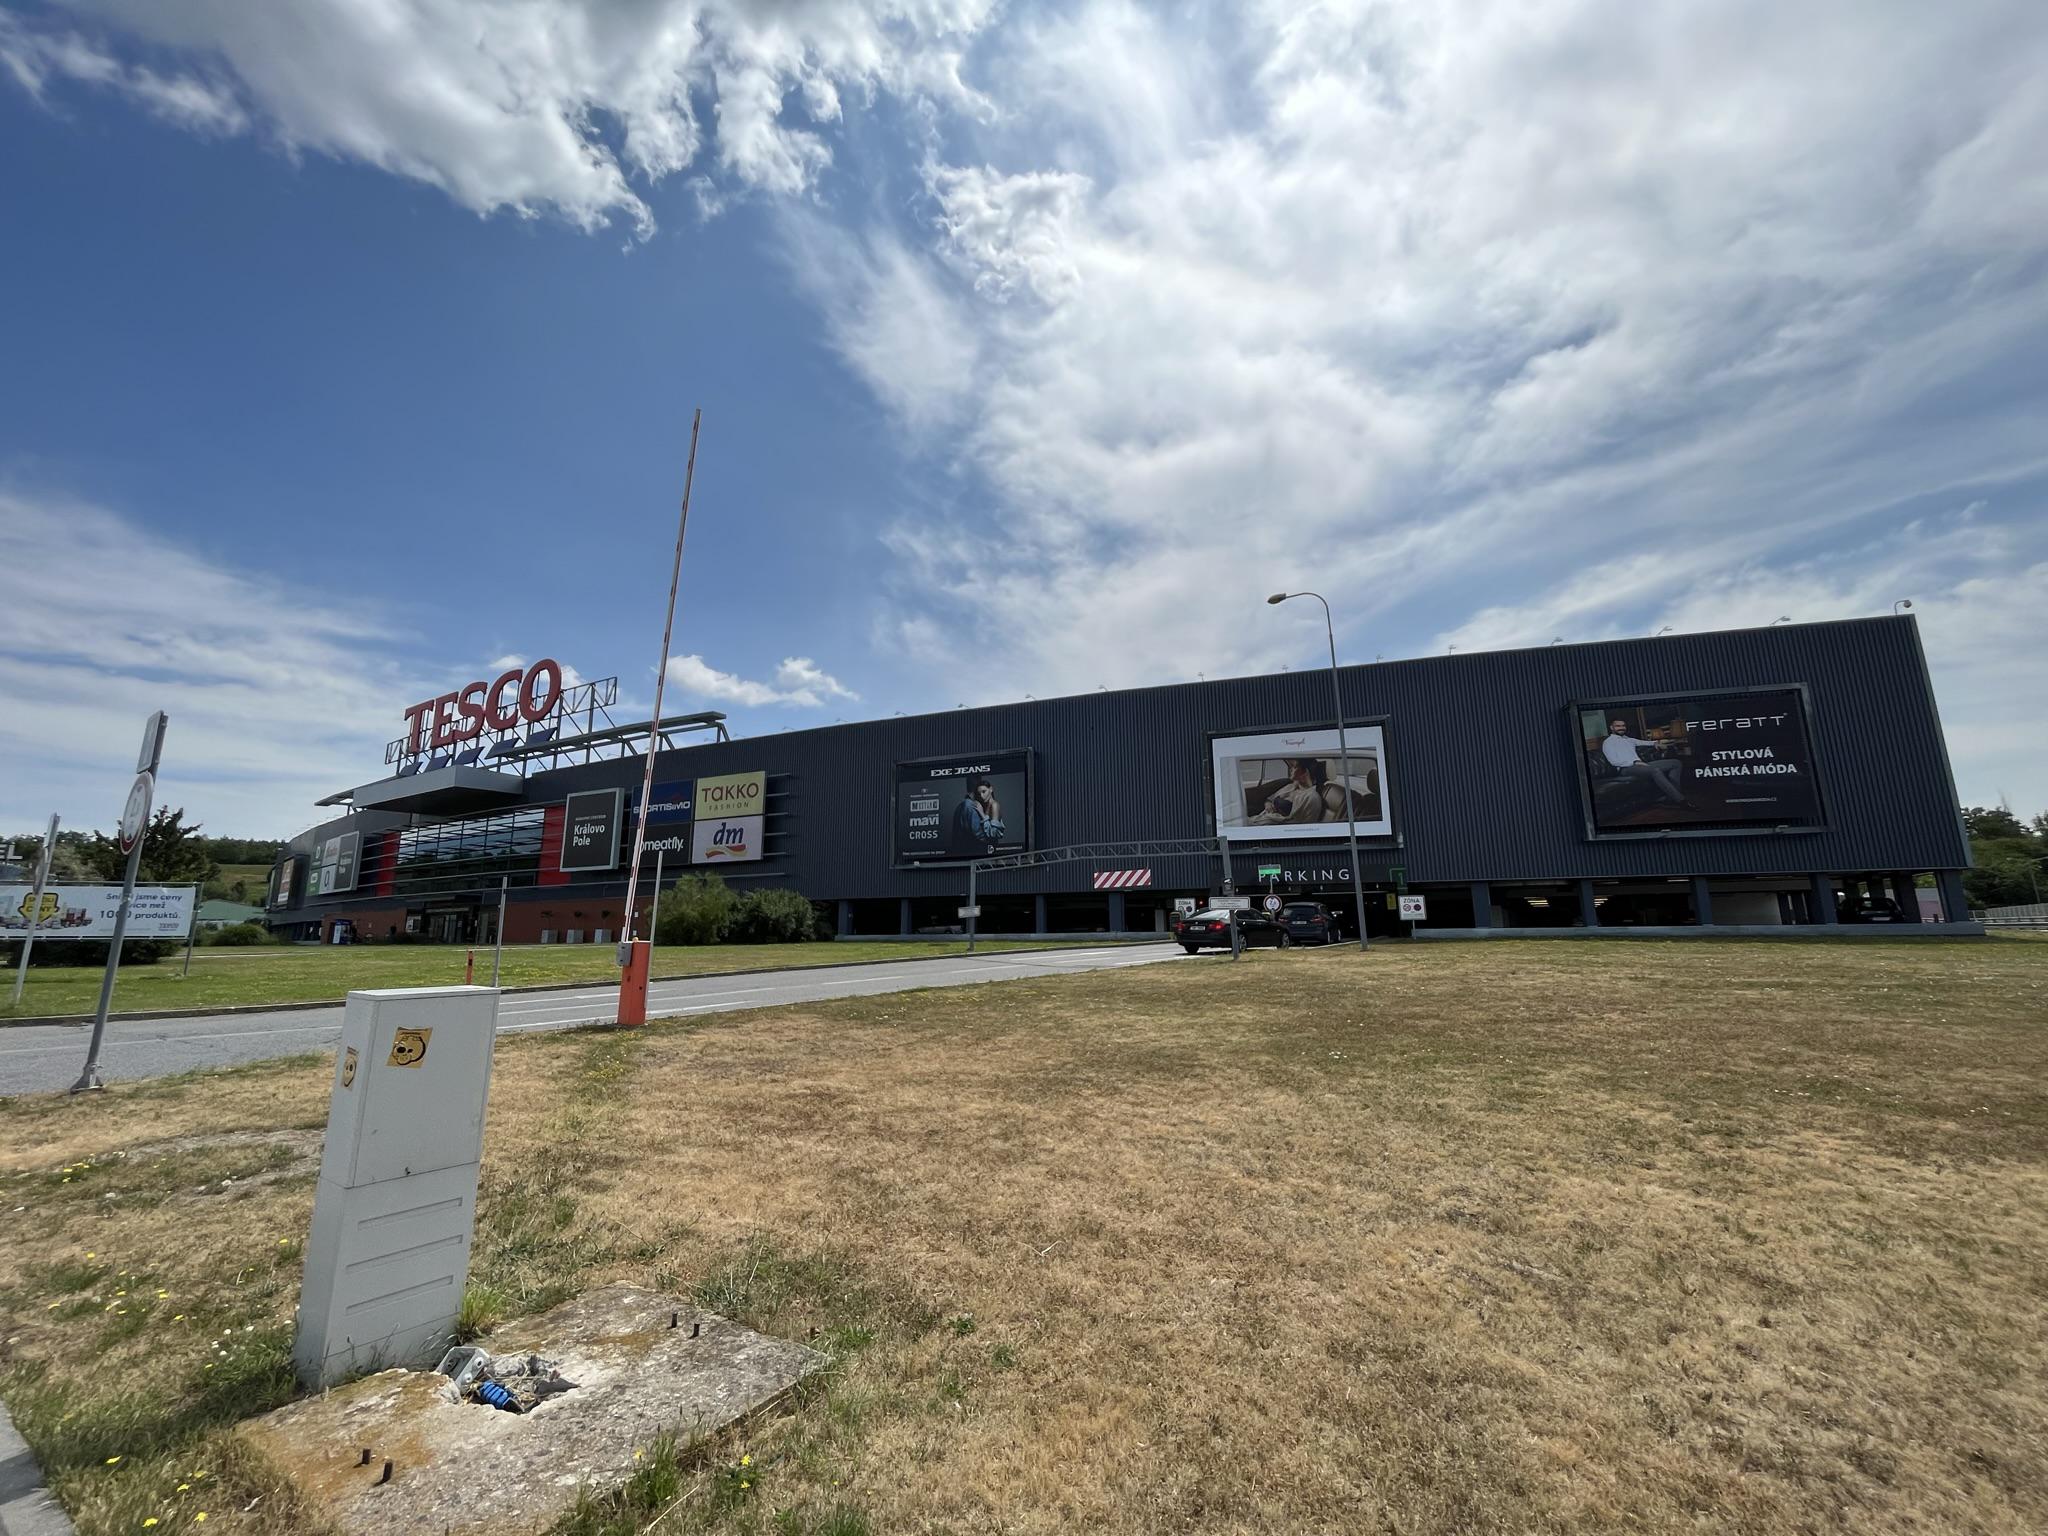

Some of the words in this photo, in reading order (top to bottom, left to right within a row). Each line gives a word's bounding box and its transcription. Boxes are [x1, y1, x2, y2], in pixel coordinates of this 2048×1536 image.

[404, 658, 562, 754] TESCO
[1711, 746, 1775, 761] STYLOVÁ
[930, 768, 953, 777] EXE
[954, 765, 991, 775] JEANS
[1695, 763, 1751, 778] PÁNSKÁ
[1753, 762, 1798, 775] MÓDA
[633, 800, 691, 814] SORTISIMO
[708, 801, 750, 812] FASHION
[909, 813, 940, 827] mavi
[573, 823, 606, 836] Královo
[713, 821, 745, 846] dm
[909, 830, 939, 840] CROSS
[572, 835, 591, 847] Pole
[135, 893, 158, 902] jsme
[160, 894, 183, 902] ceny
[149, 901, 167, 909] než
[135, 912, 181, 920] produktů.
